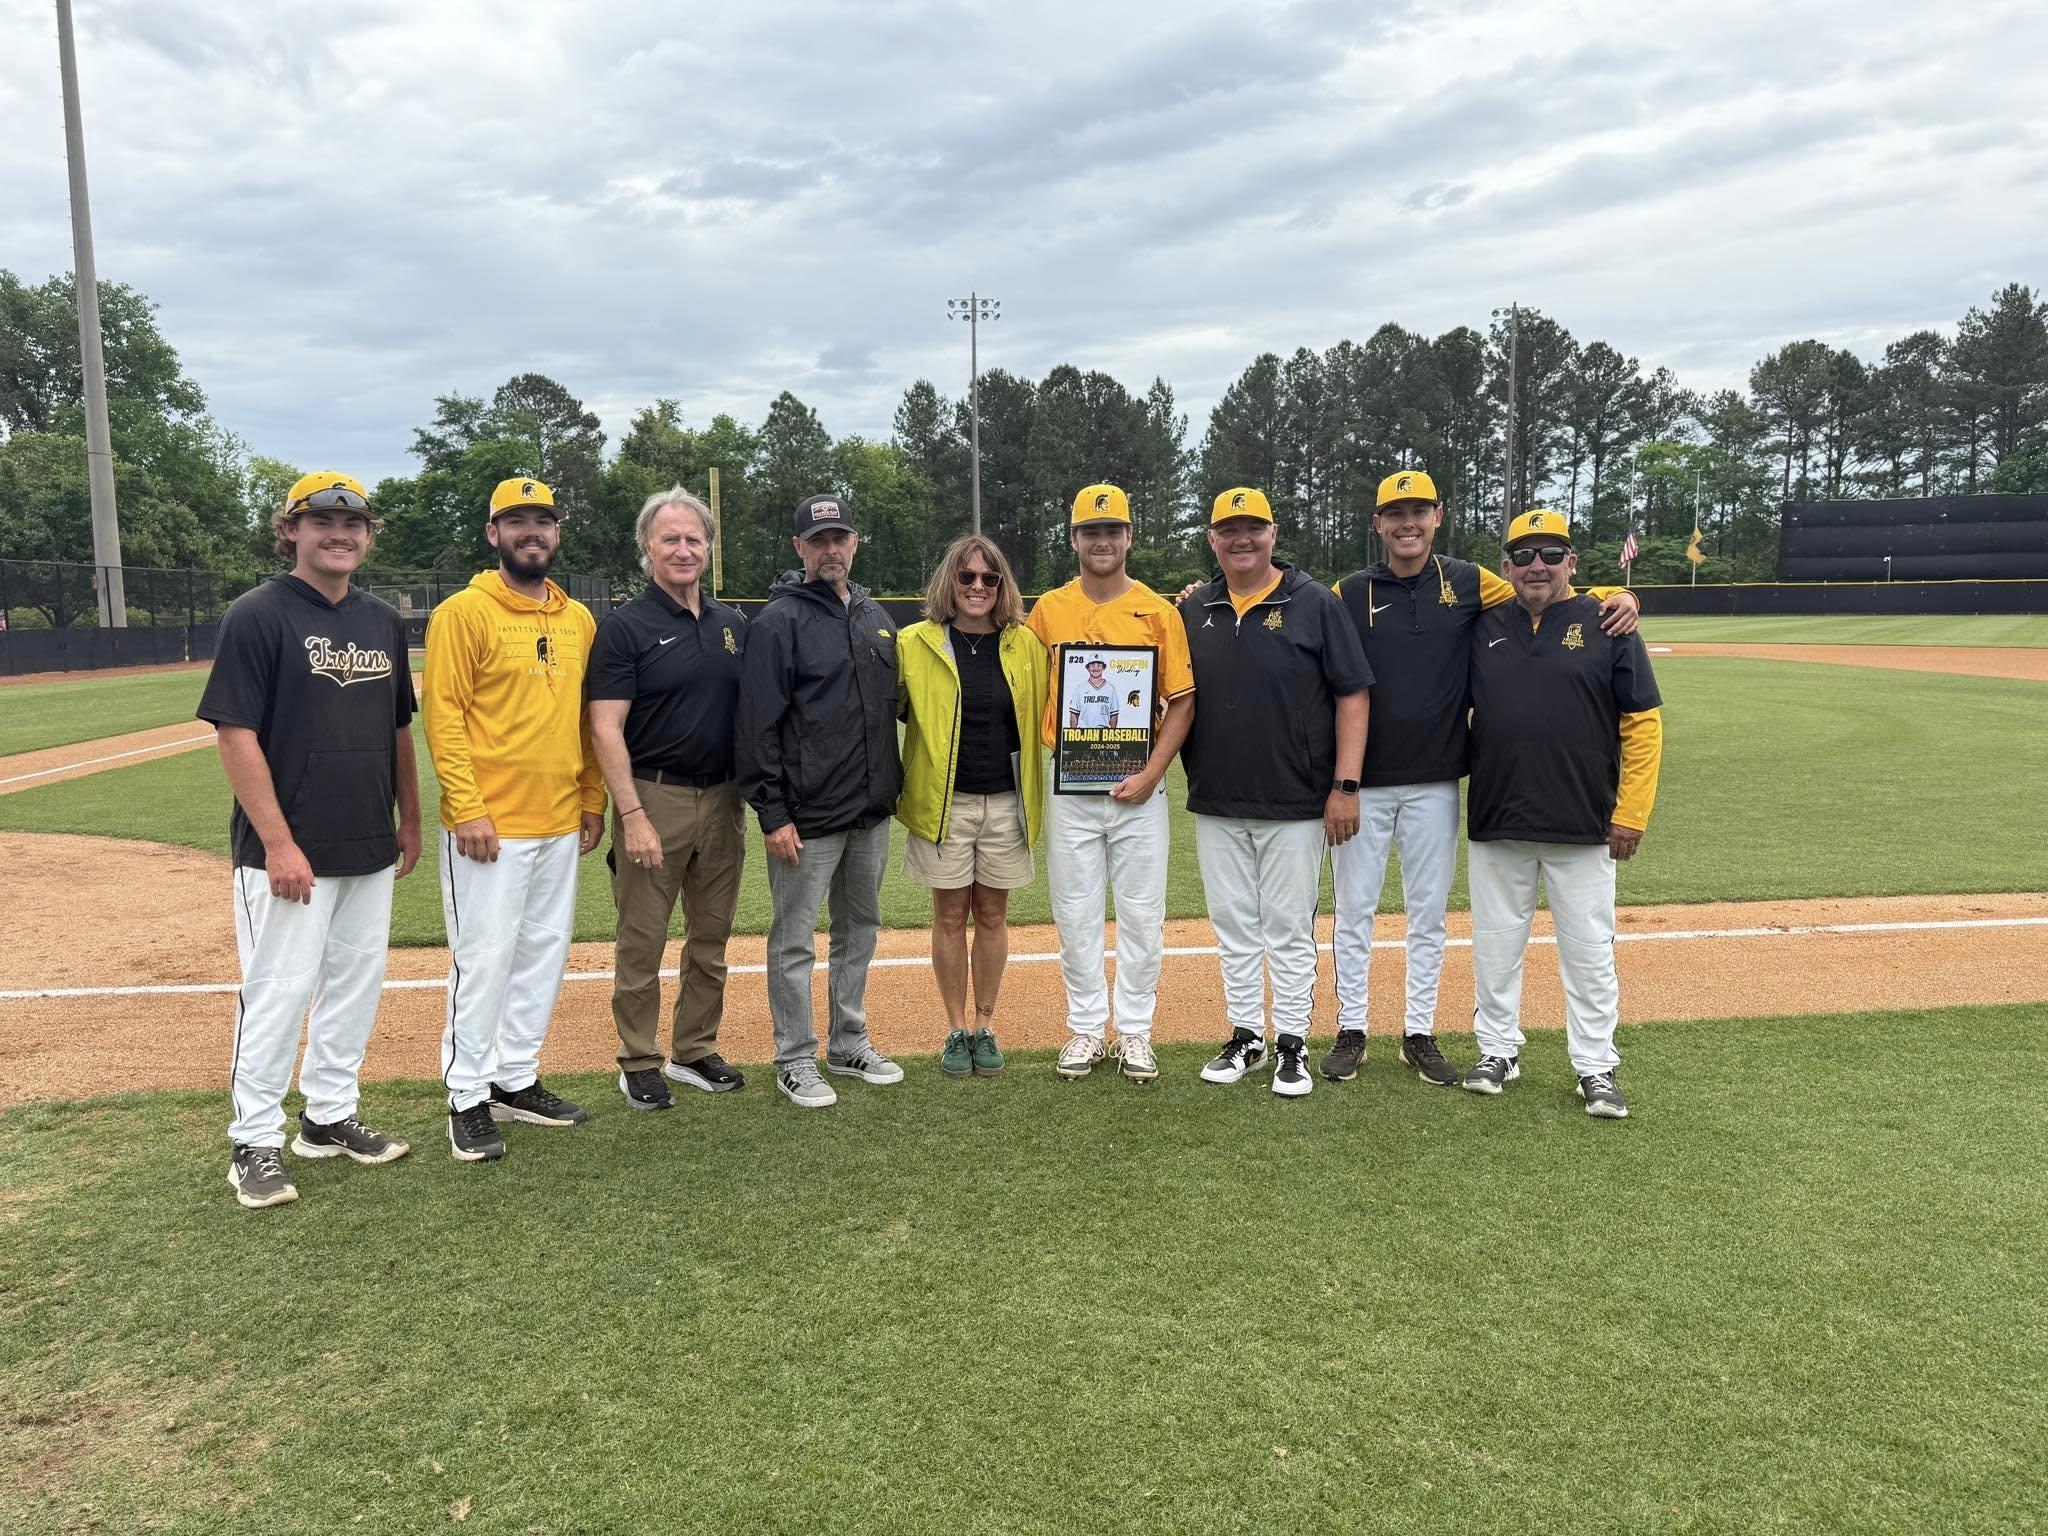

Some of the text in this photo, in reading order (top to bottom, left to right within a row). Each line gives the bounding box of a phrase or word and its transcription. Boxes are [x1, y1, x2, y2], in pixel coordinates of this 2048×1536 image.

[560, 628, 577, 636] TECH
[304, 635, 387, 680] Trojans
[1110, 659, 1148, 669] GRIFFIN
[1084, 695, 1109, 703] TROJANS
[1063, 728, 1148, 742] TROJAN BASEBALL
